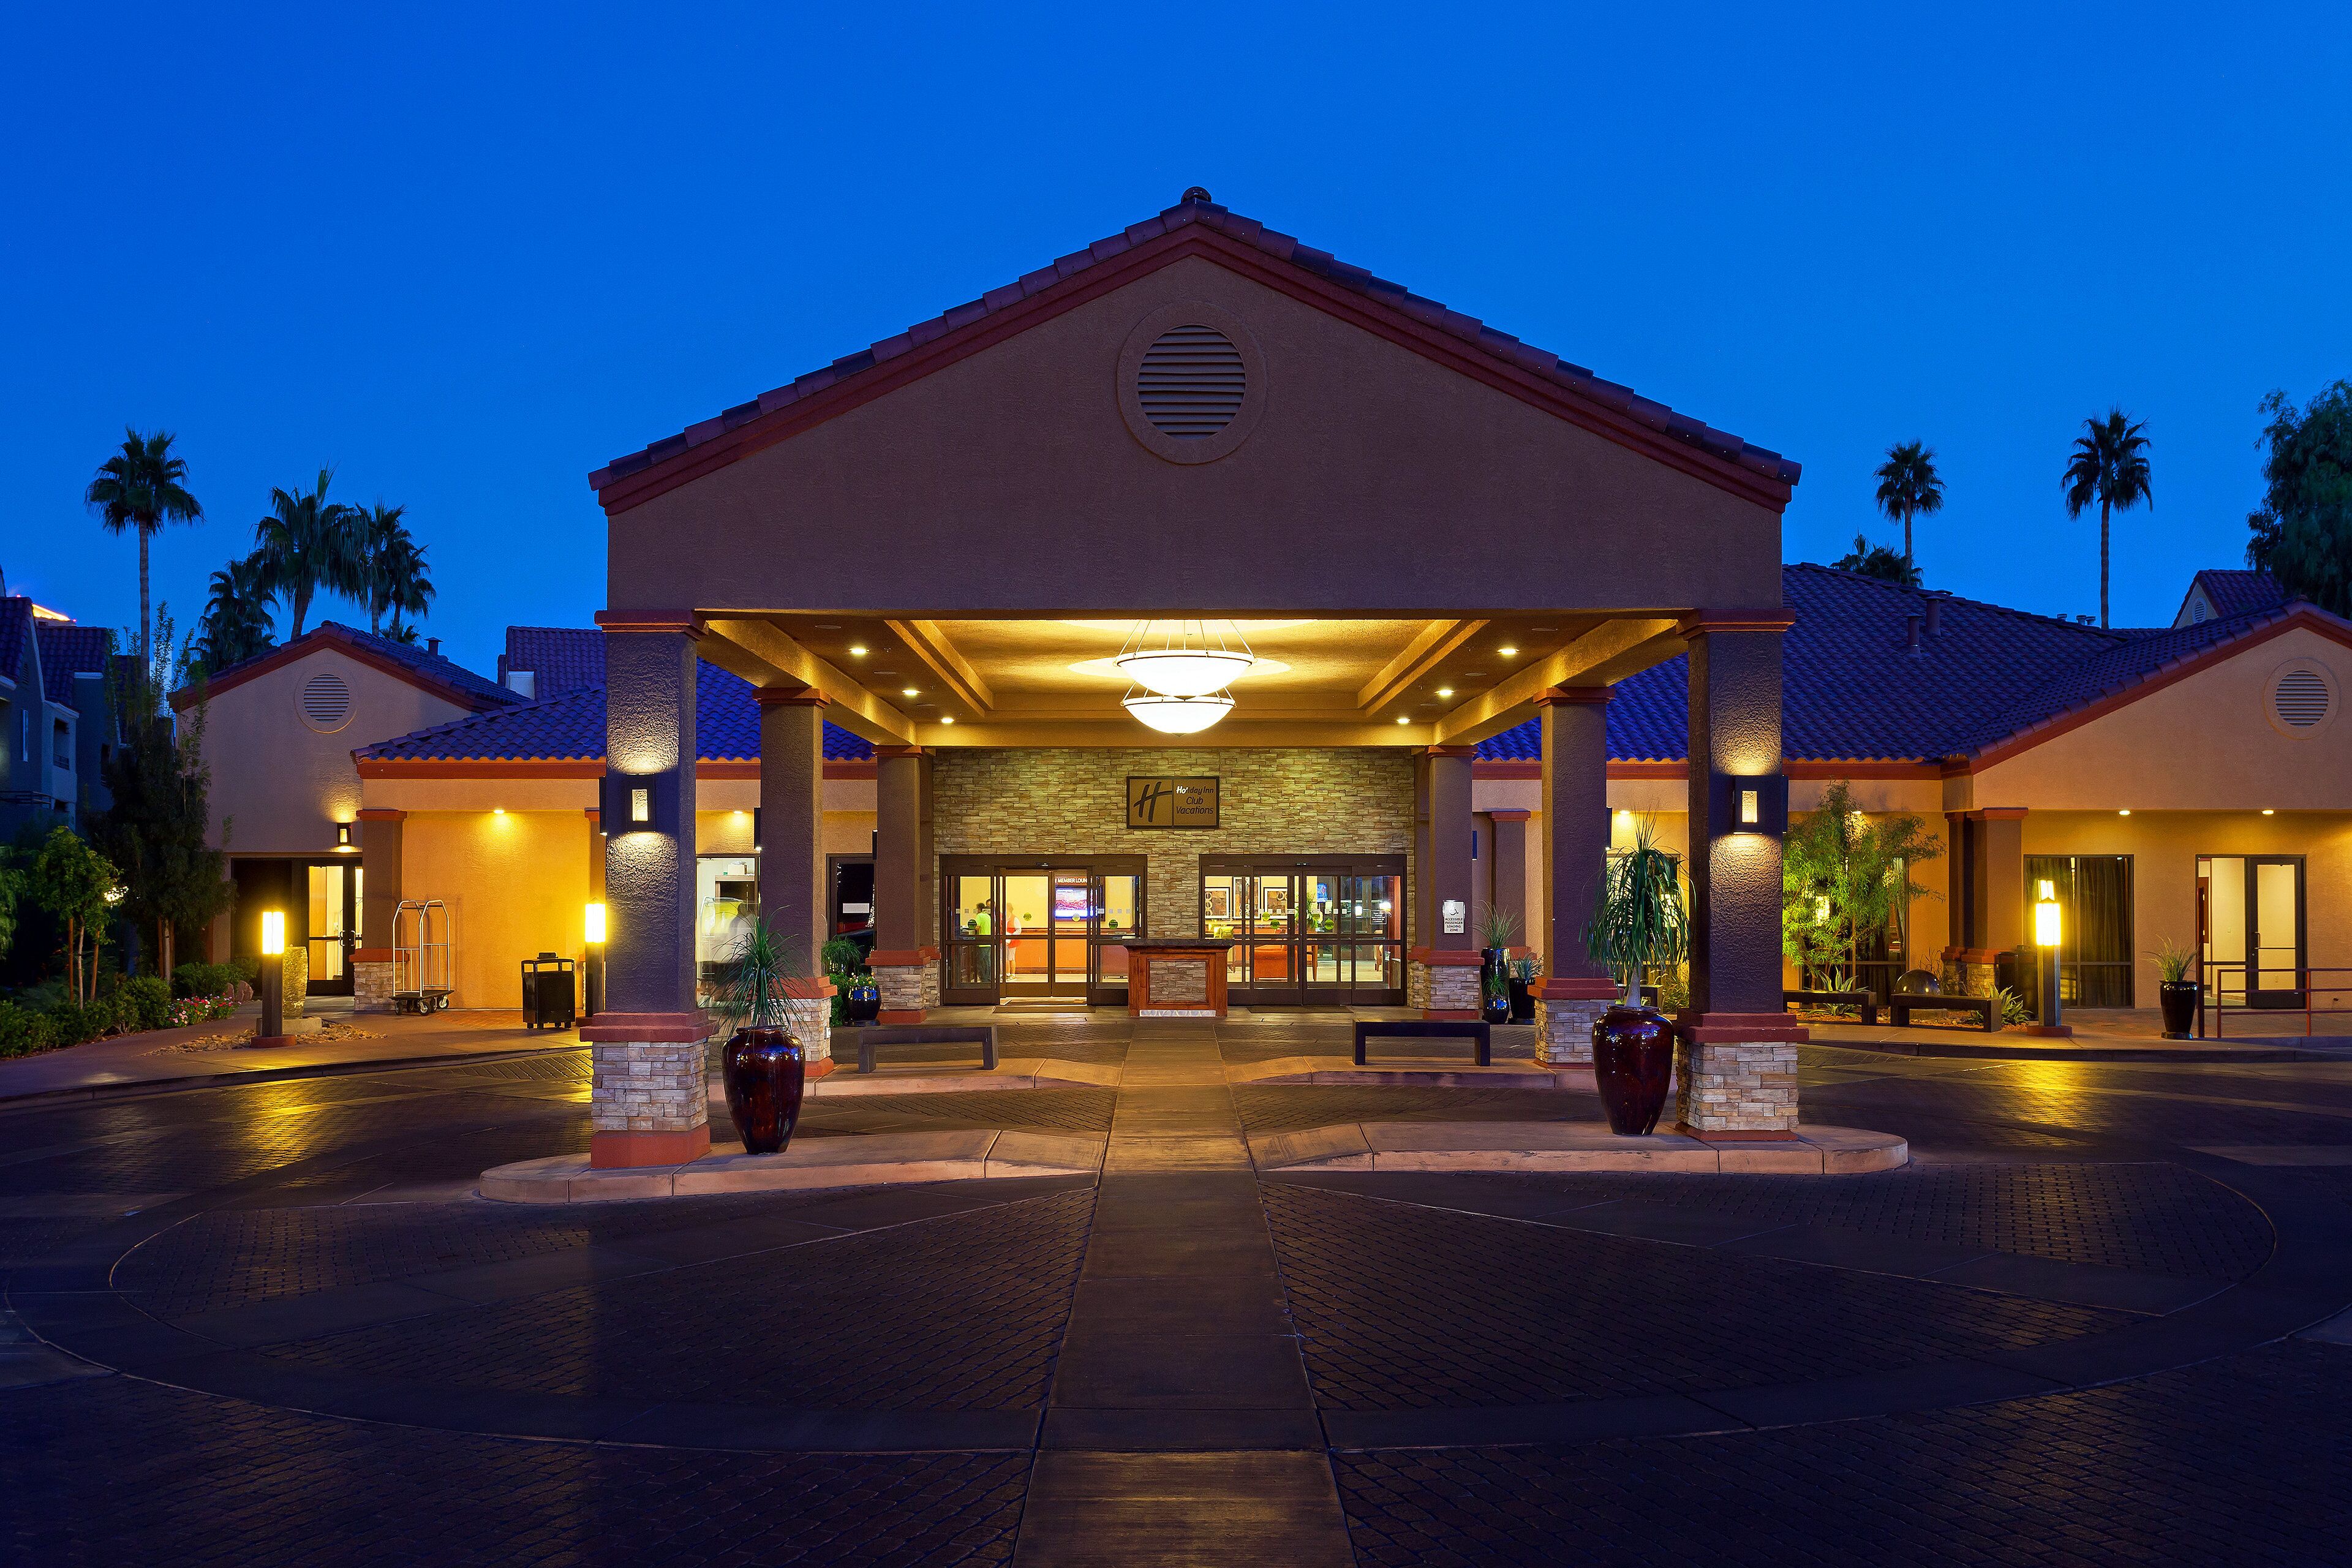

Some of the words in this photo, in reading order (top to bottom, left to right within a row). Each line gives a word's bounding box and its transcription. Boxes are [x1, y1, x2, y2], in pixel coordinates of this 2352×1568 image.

[1176, 785, 1203, 796] Holiday
[1186, 796, 1204, 805] Club
[1176, 805, 1214, 815] Vacations
